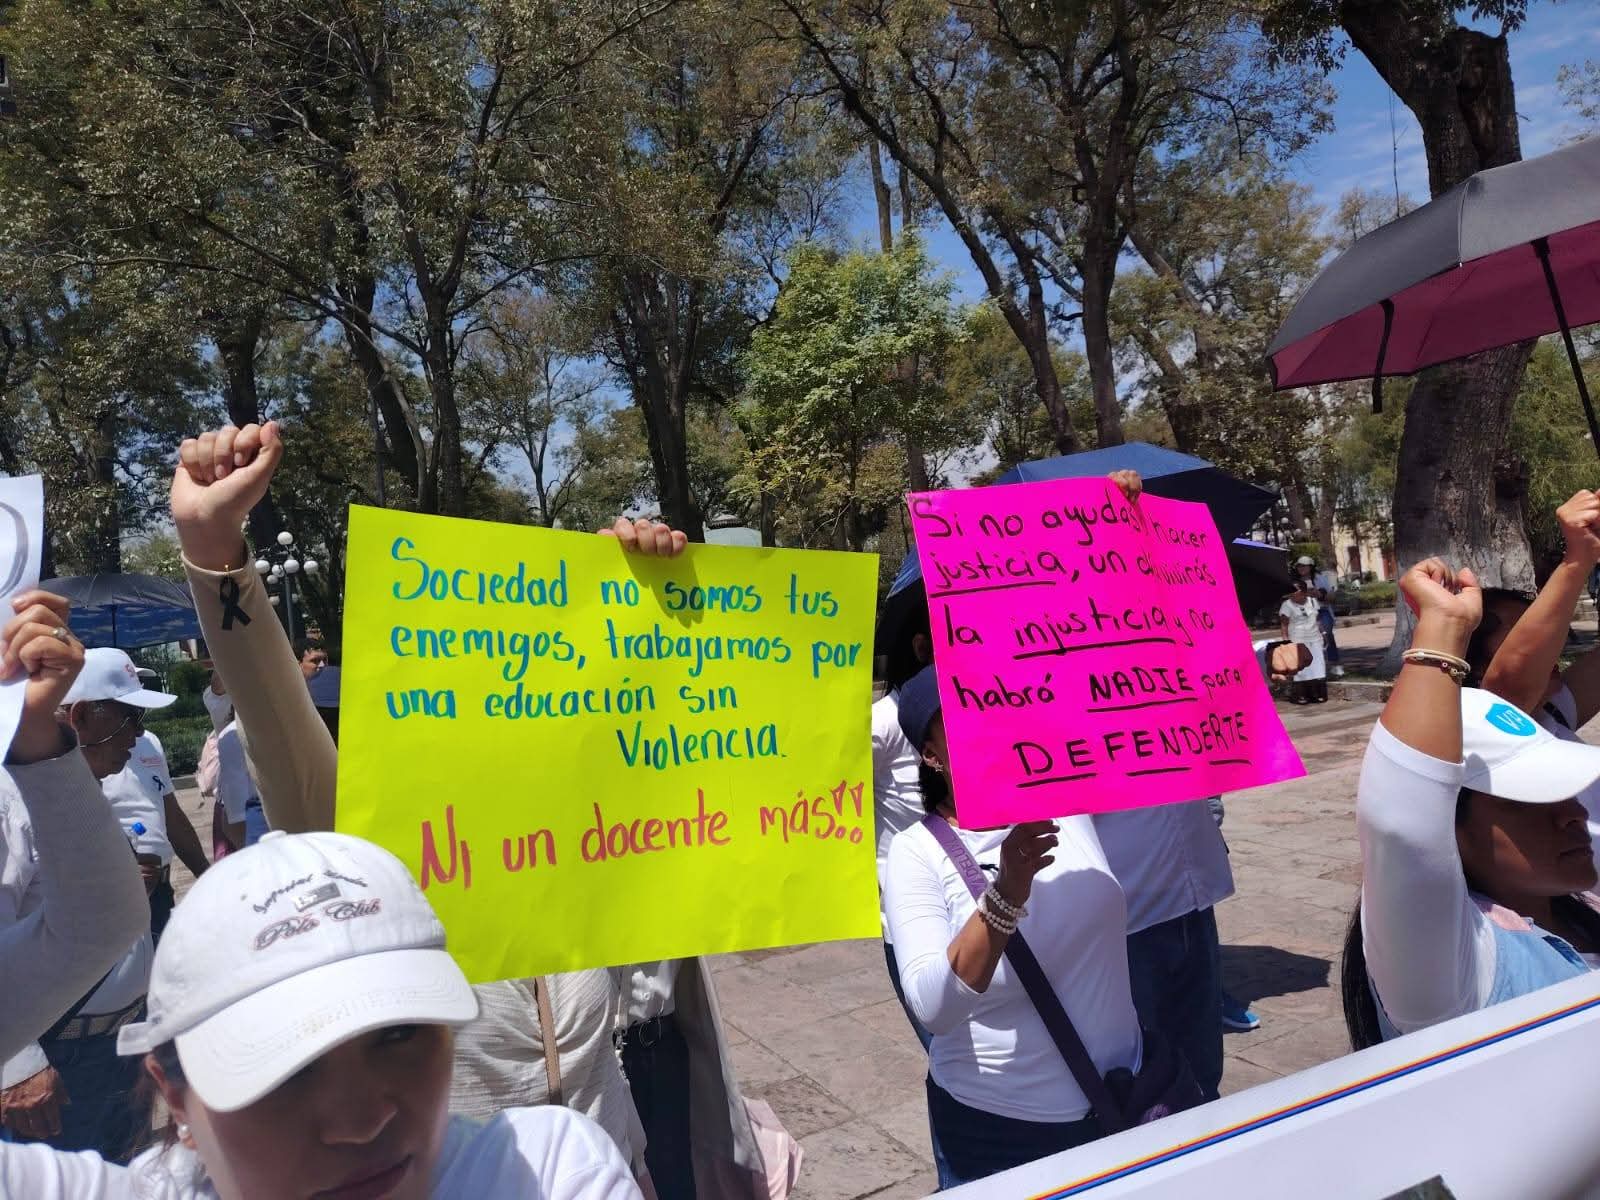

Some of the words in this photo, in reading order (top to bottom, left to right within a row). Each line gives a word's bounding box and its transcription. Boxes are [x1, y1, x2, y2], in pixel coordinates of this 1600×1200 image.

[912, 498, 964, 538] Si
[979, 513, 1024, 539] no
[392, 536, 568, 608] Sociedad
[601, 579, 640, 607] no
[664, 583, 763, 614] somos
[784, 572, 839, 618] tus
[929, 550, 1081, 590] justicia,
[1088, 550, 1128, 574] un
[391, 625, 586, 682] enemigos,
[605, 618, 792, 678] trabajamos
[811, 641, 863, 679] por
[943, 603, 984, 648] la
[1012, 597, 1169, 656] injusticia
[1173, 615, 1195, 648] y
[1188, 608, 1215, 631] no
[386, 688, 457, 720] una
[484, 677, 656, 719] educación
[679, 685, 738, 714] sin
[1088, 666, 1196, 704] NADIE
[1200, 667, 1245, 702] para
[615, 720, 787, 772] Violencia.
[1012, 711, 1250, 777] DEFENDERTE
[502, 828, 557, 873] un
[580, 788, 731, 863] docente
[759, 779, 865, 845] más!!
[322, 898, 381, 922] Club
